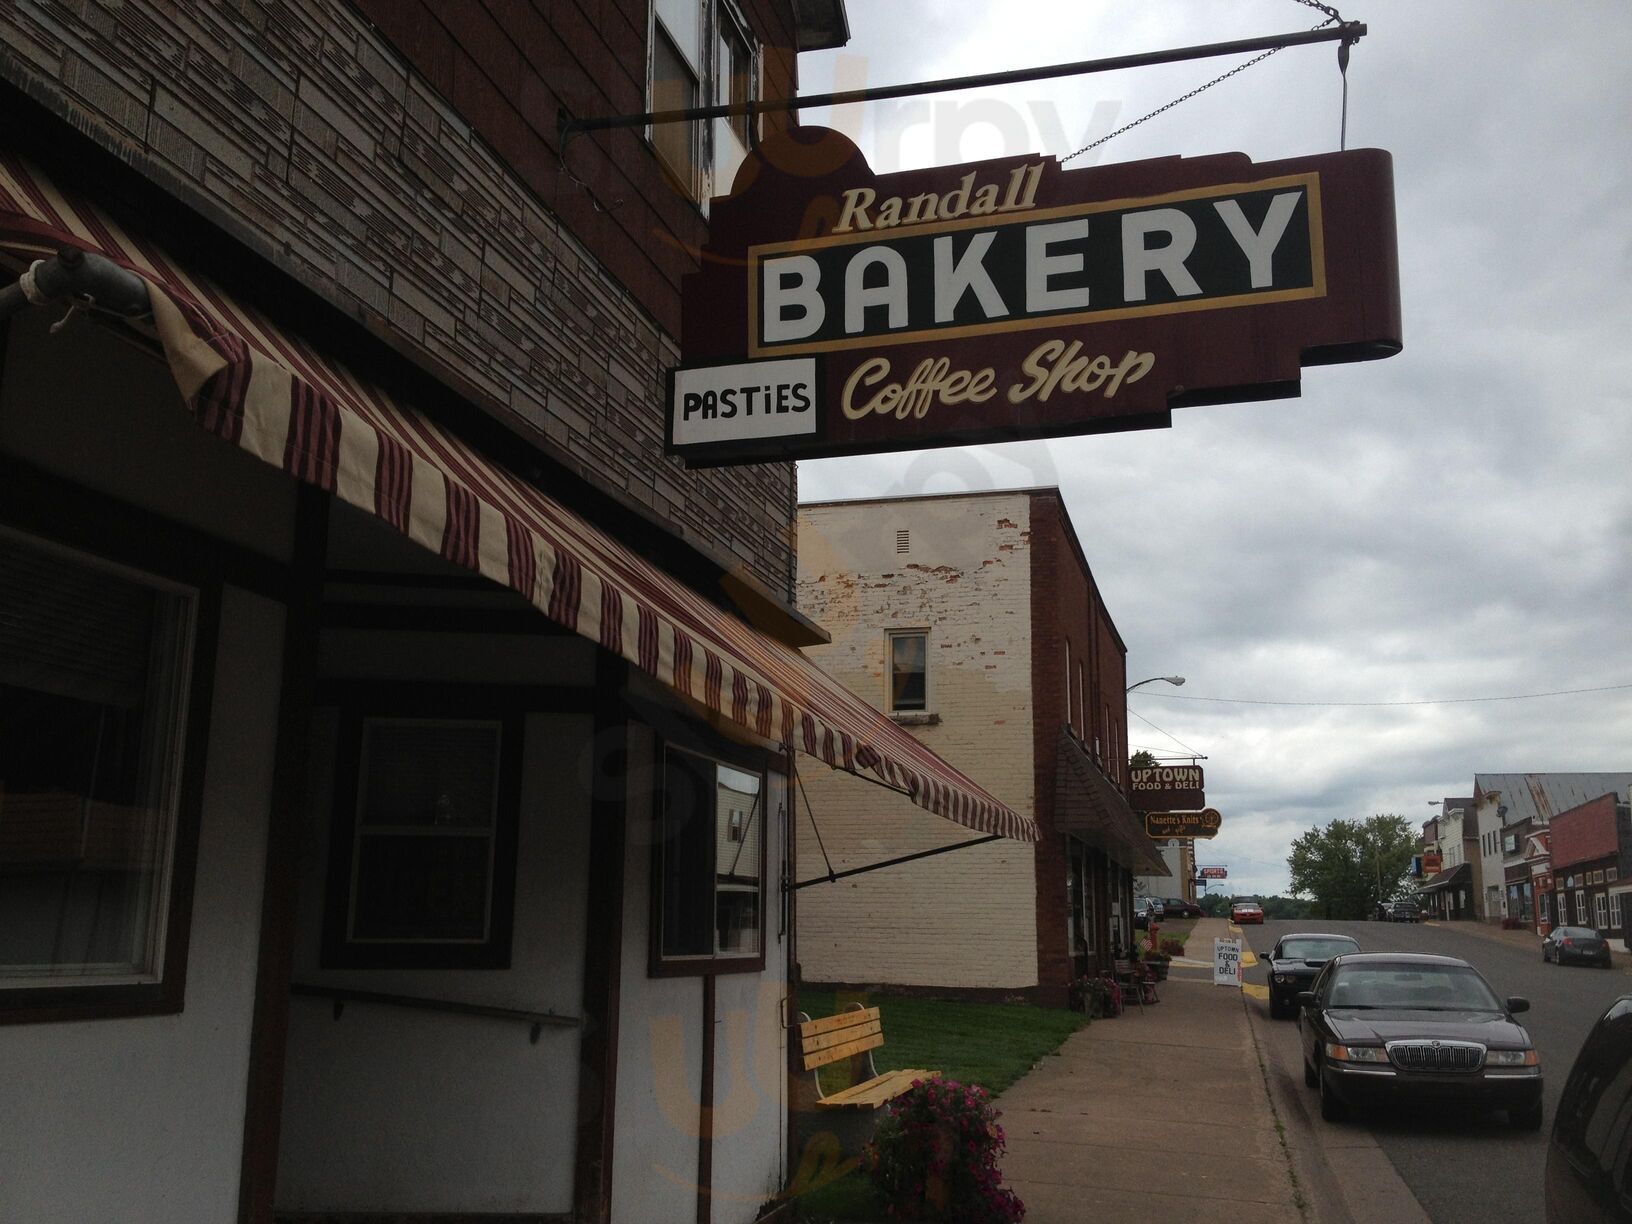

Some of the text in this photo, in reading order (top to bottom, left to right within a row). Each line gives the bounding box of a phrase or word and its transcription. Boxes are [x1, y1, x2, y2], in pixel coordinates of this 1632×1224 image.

[831, 161, 1045, 233] Randall
[763, 191, 1303, 343] BAKERY
[842, 339, 1156, 420] Coffee Shop
[1131, 768, 1200, 782] UPTOWN
[1132, 782, 1161, 790] FOOD
[1175, 781, 1200, 789] DELI
[1218, 953, 1238, 961] FOOD
[1219, 967, 1236, 975] DELI
